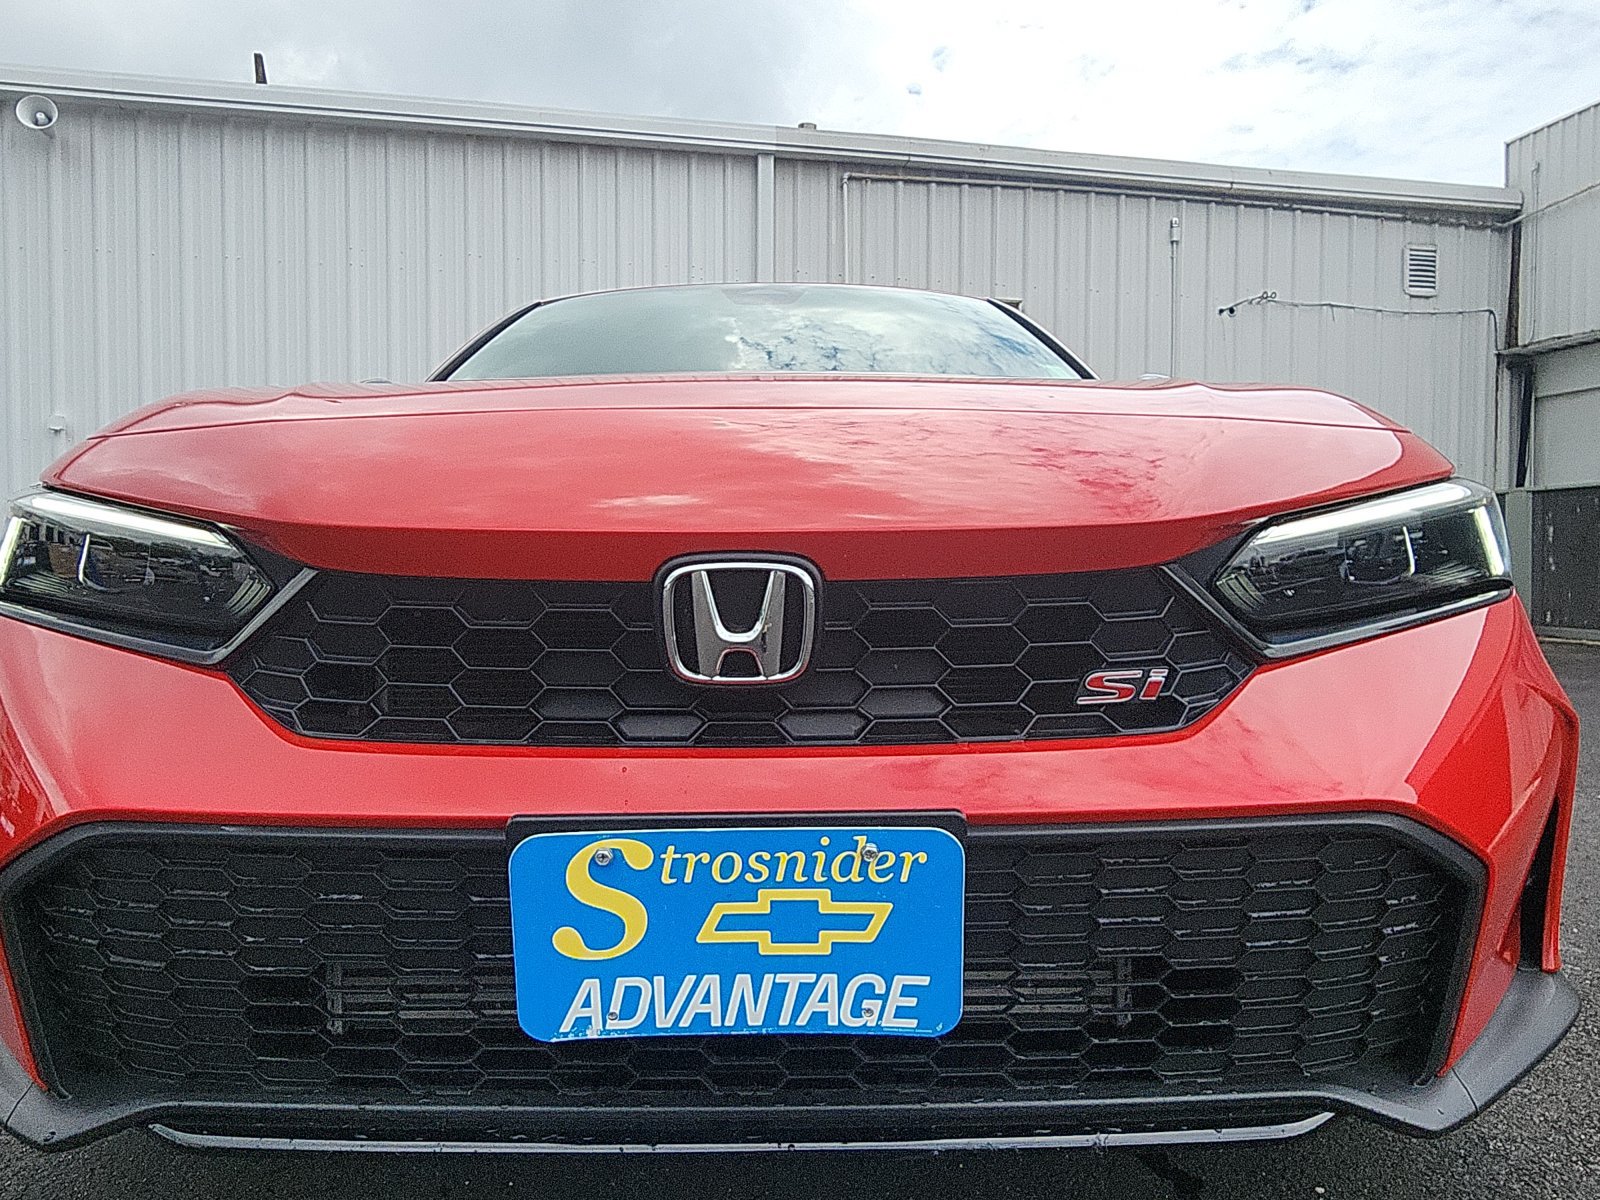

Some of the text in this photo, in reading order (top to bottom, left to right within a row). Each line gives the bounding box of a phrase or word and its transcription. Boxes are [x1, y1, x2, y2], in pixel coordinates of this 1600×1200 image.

[1076, 668, 1169, 705] Si
[551, 836, 927, 960] Strosnider
[559, 973, 931, 1033] ADVANTAGE
